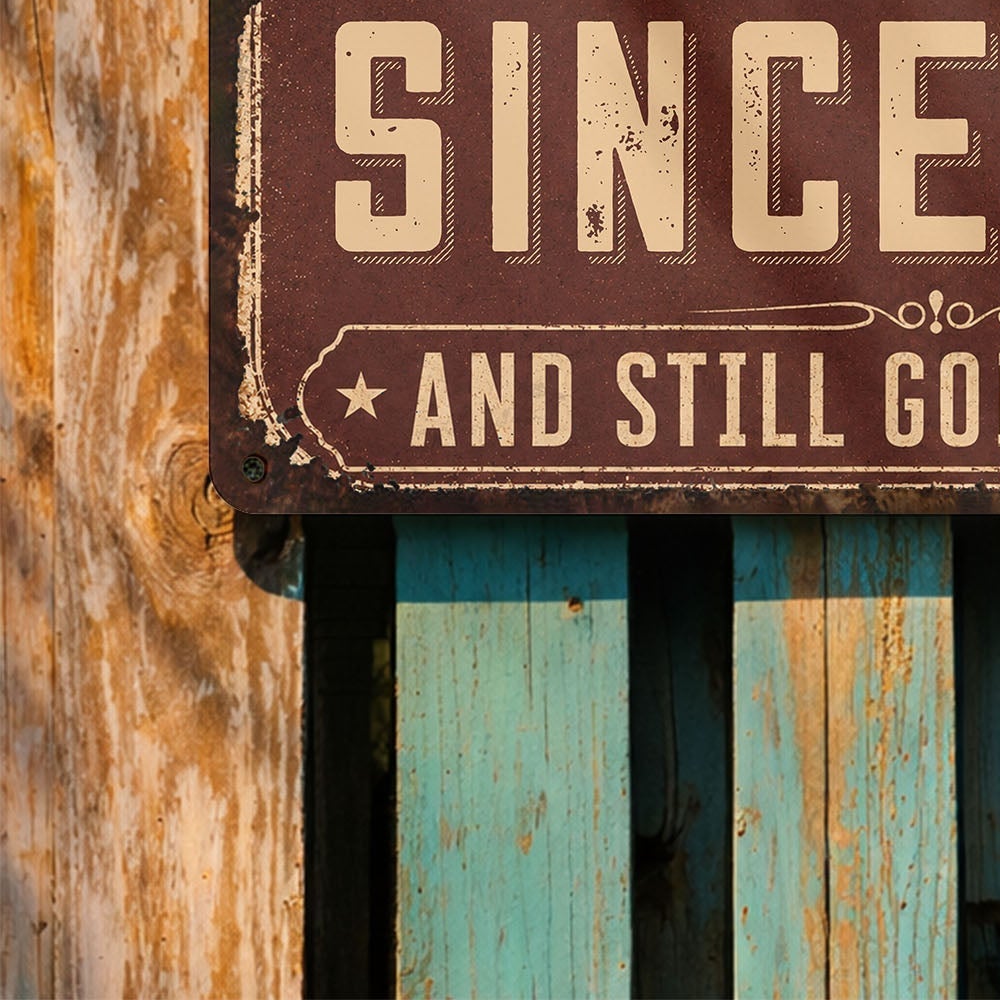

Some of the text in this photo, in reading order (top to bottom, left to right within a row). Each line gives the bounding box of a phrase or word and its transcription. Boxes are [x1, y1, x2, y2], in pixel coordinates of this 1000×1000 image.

[335, 20, 998, 264] SINCE
[410, 352, 572, 447] AND
[616, 351, 845, 447] STILL
